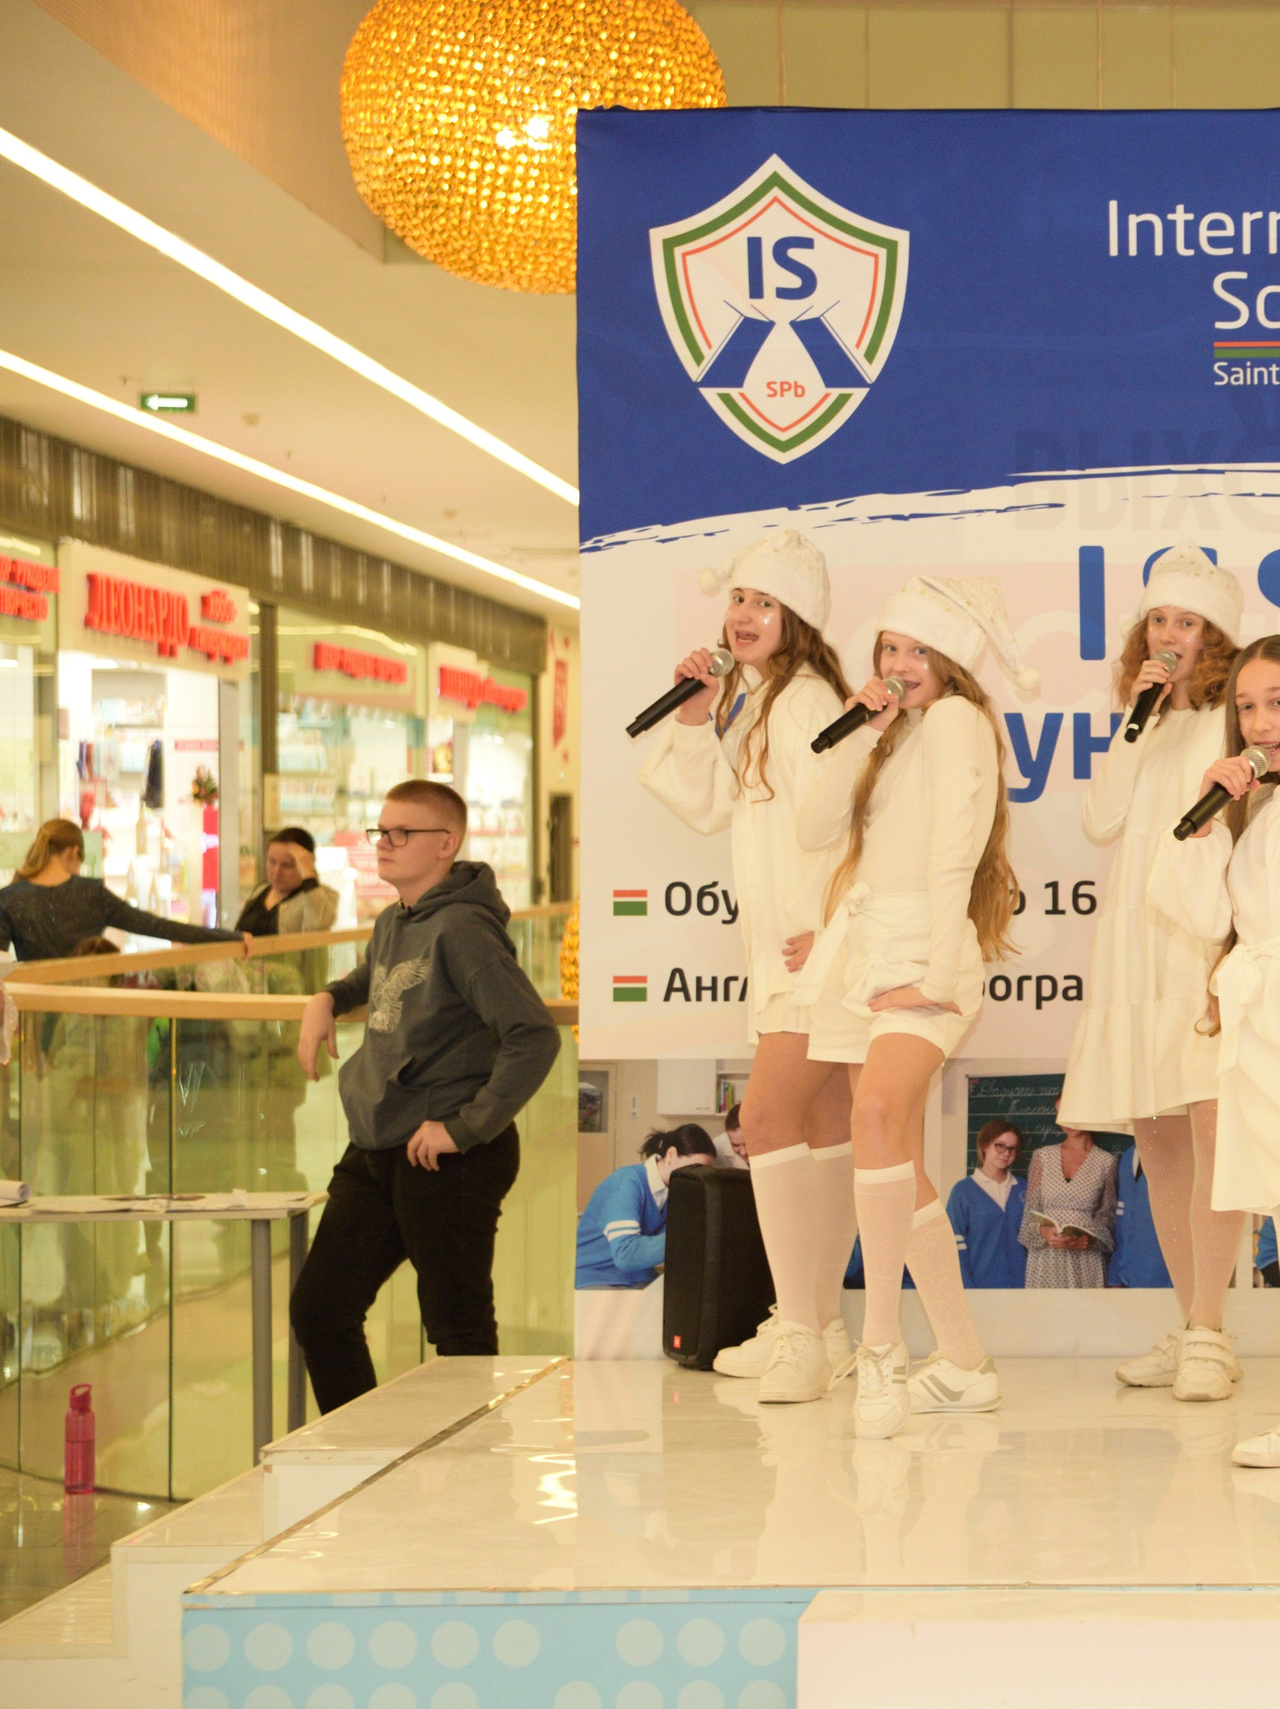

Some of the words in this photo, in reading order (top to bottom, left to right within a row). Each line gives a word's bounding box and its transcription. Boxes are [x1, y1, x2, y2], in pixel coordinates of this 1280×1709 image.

[747, 236, 816, 301] IS
[1213, 360, 1280, 386] Saint
[766, 380, 806, 399] SPb
[1044, 881, 1098, 915] 16
